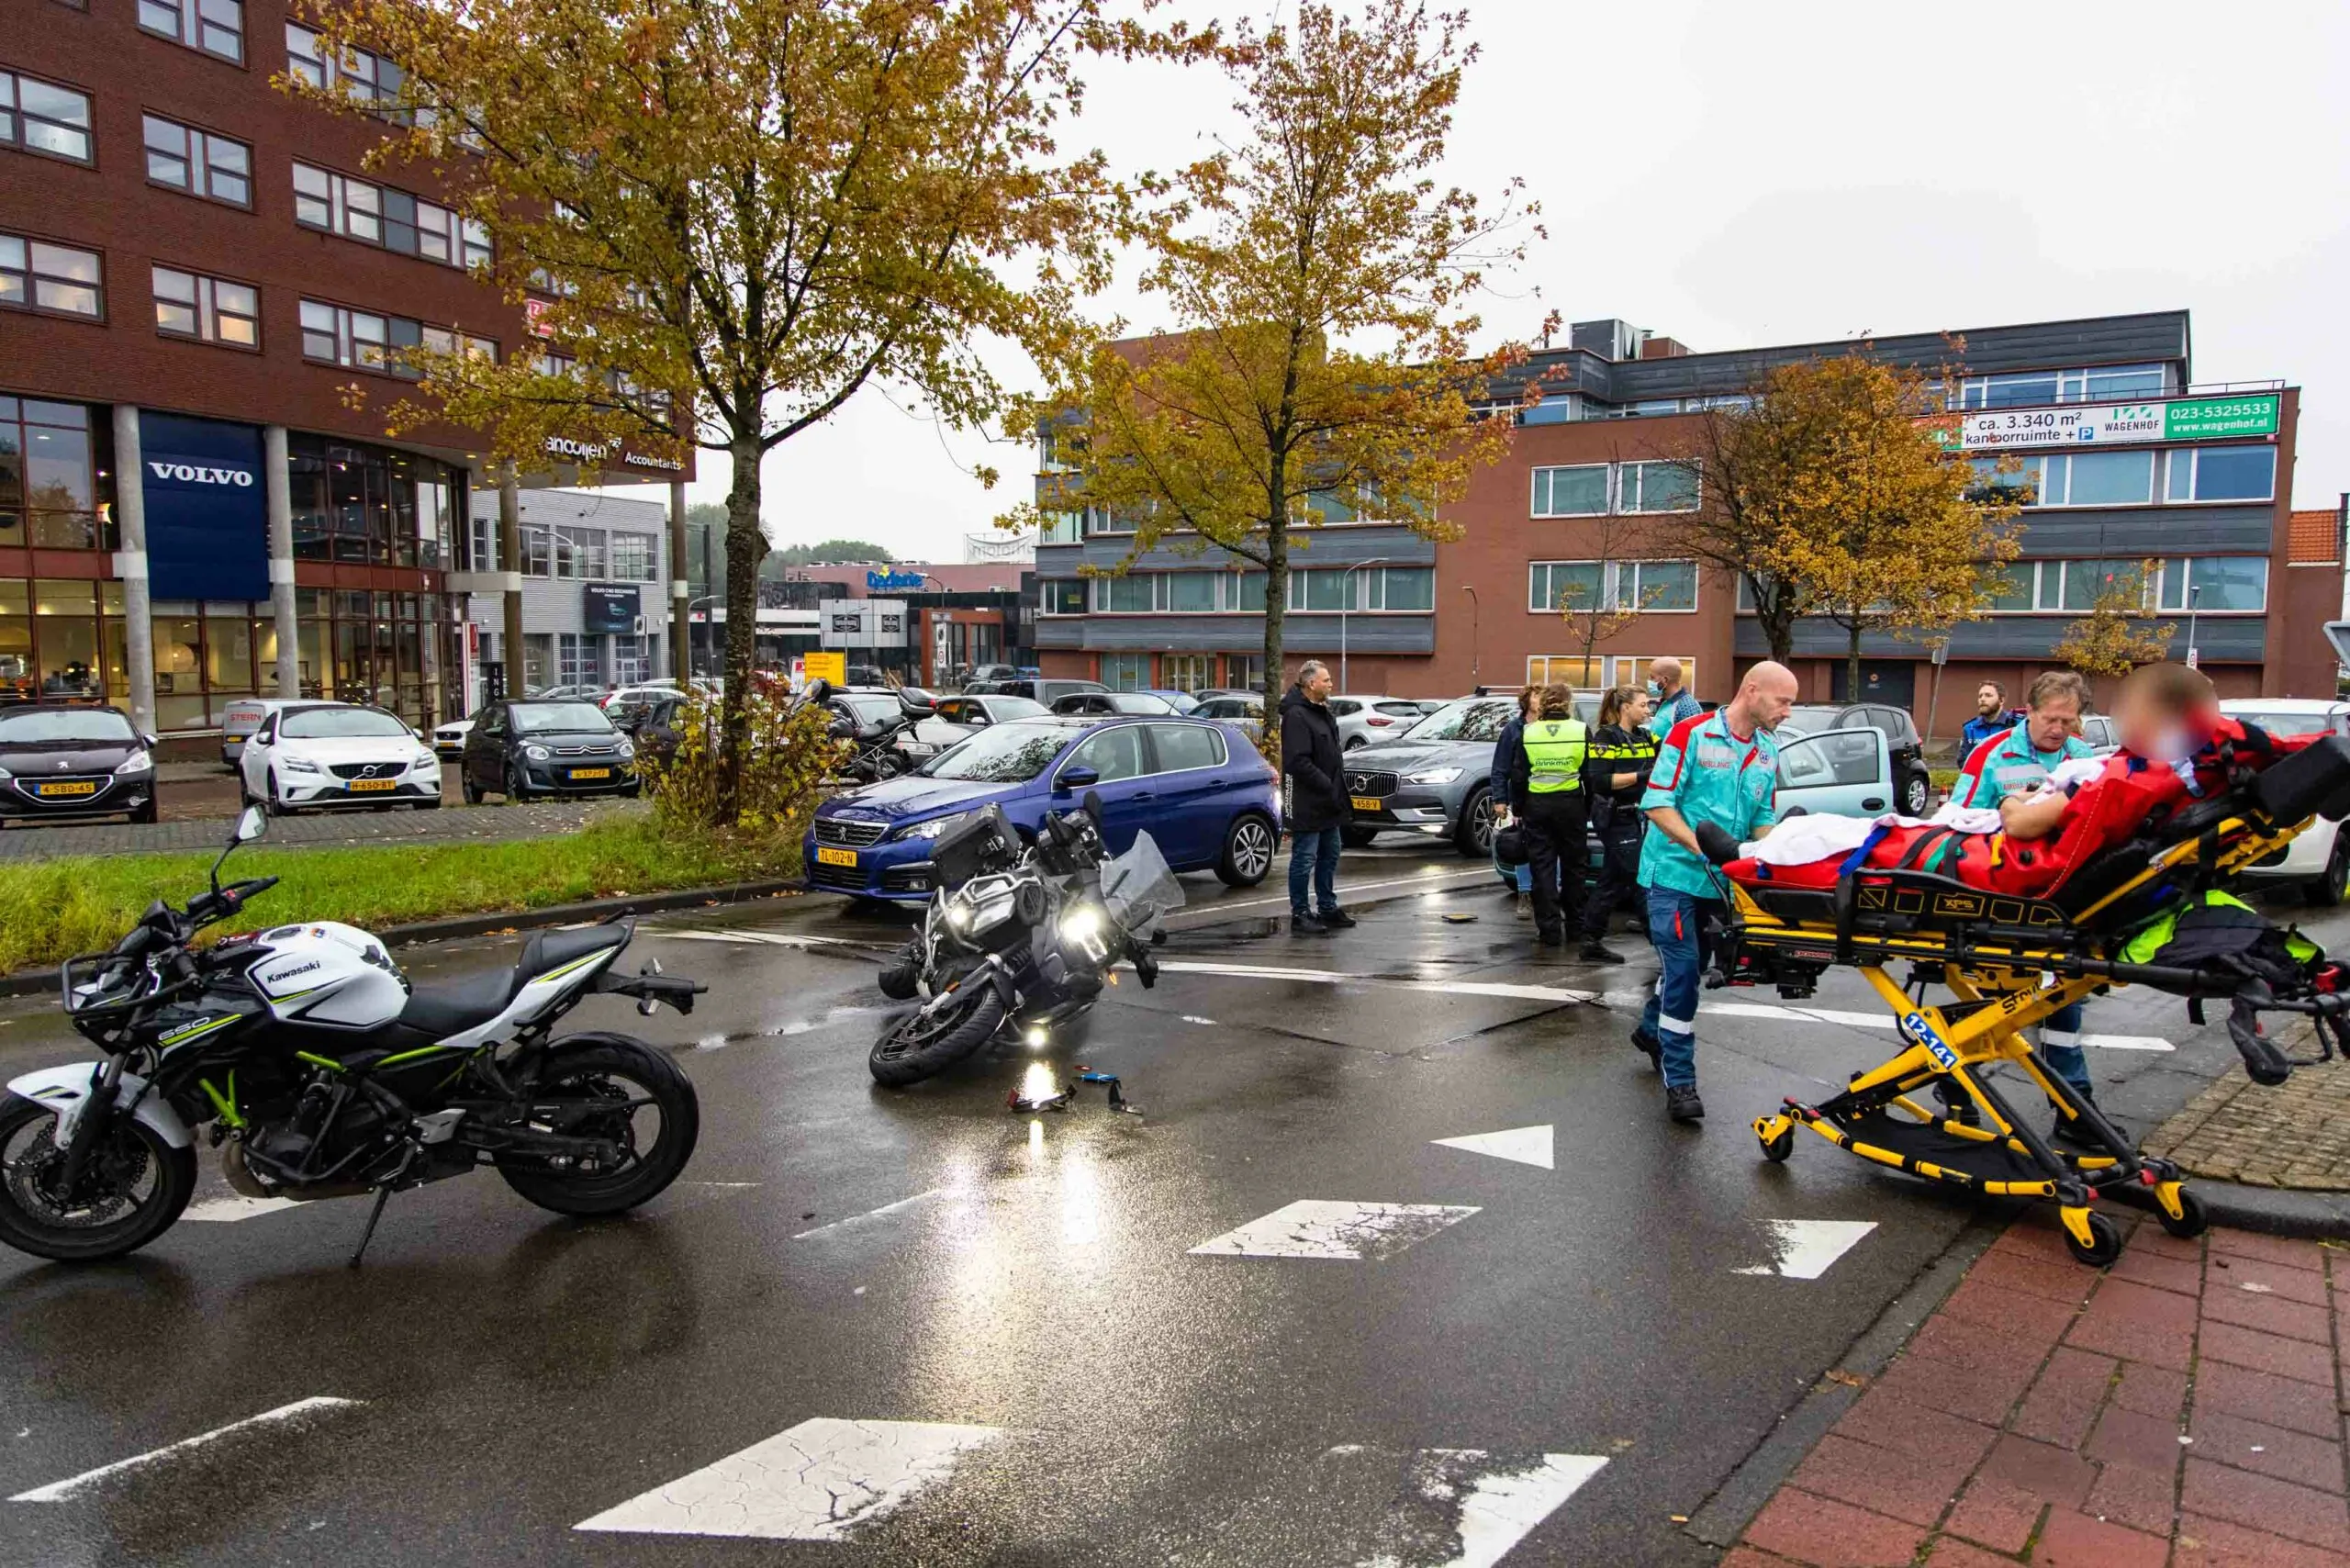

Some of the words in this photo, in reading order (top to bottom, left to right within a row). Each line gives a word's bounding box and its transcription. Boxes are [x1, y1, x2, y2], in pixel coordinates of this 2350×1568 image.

[2170, 402, 2271, 420] 023-5325533
[1978, 418, 2000, 431] ca.
[2007, 413, 2054, 429] 3.340
[2105, 420, 2159, 432] WAGENHOF
[2172, 418, 2267, 432] www.wagenhof.nl
[1965, 429, 2061, 445] kantoorruimte
[625, 451, 681, 471] Accountants
[148, 462, 253, 487] VOLVO
[230, 713, 262, 722] STERN
[43, 783, 93, 795] 4-SBD-45
[821, 850, 853, 864] TL-102-N
[266, 960, 321, 984] Kawasaki
[158, 1016, 211, 1041] 650
[1907, 1014, 1956, 1069] 12-141
